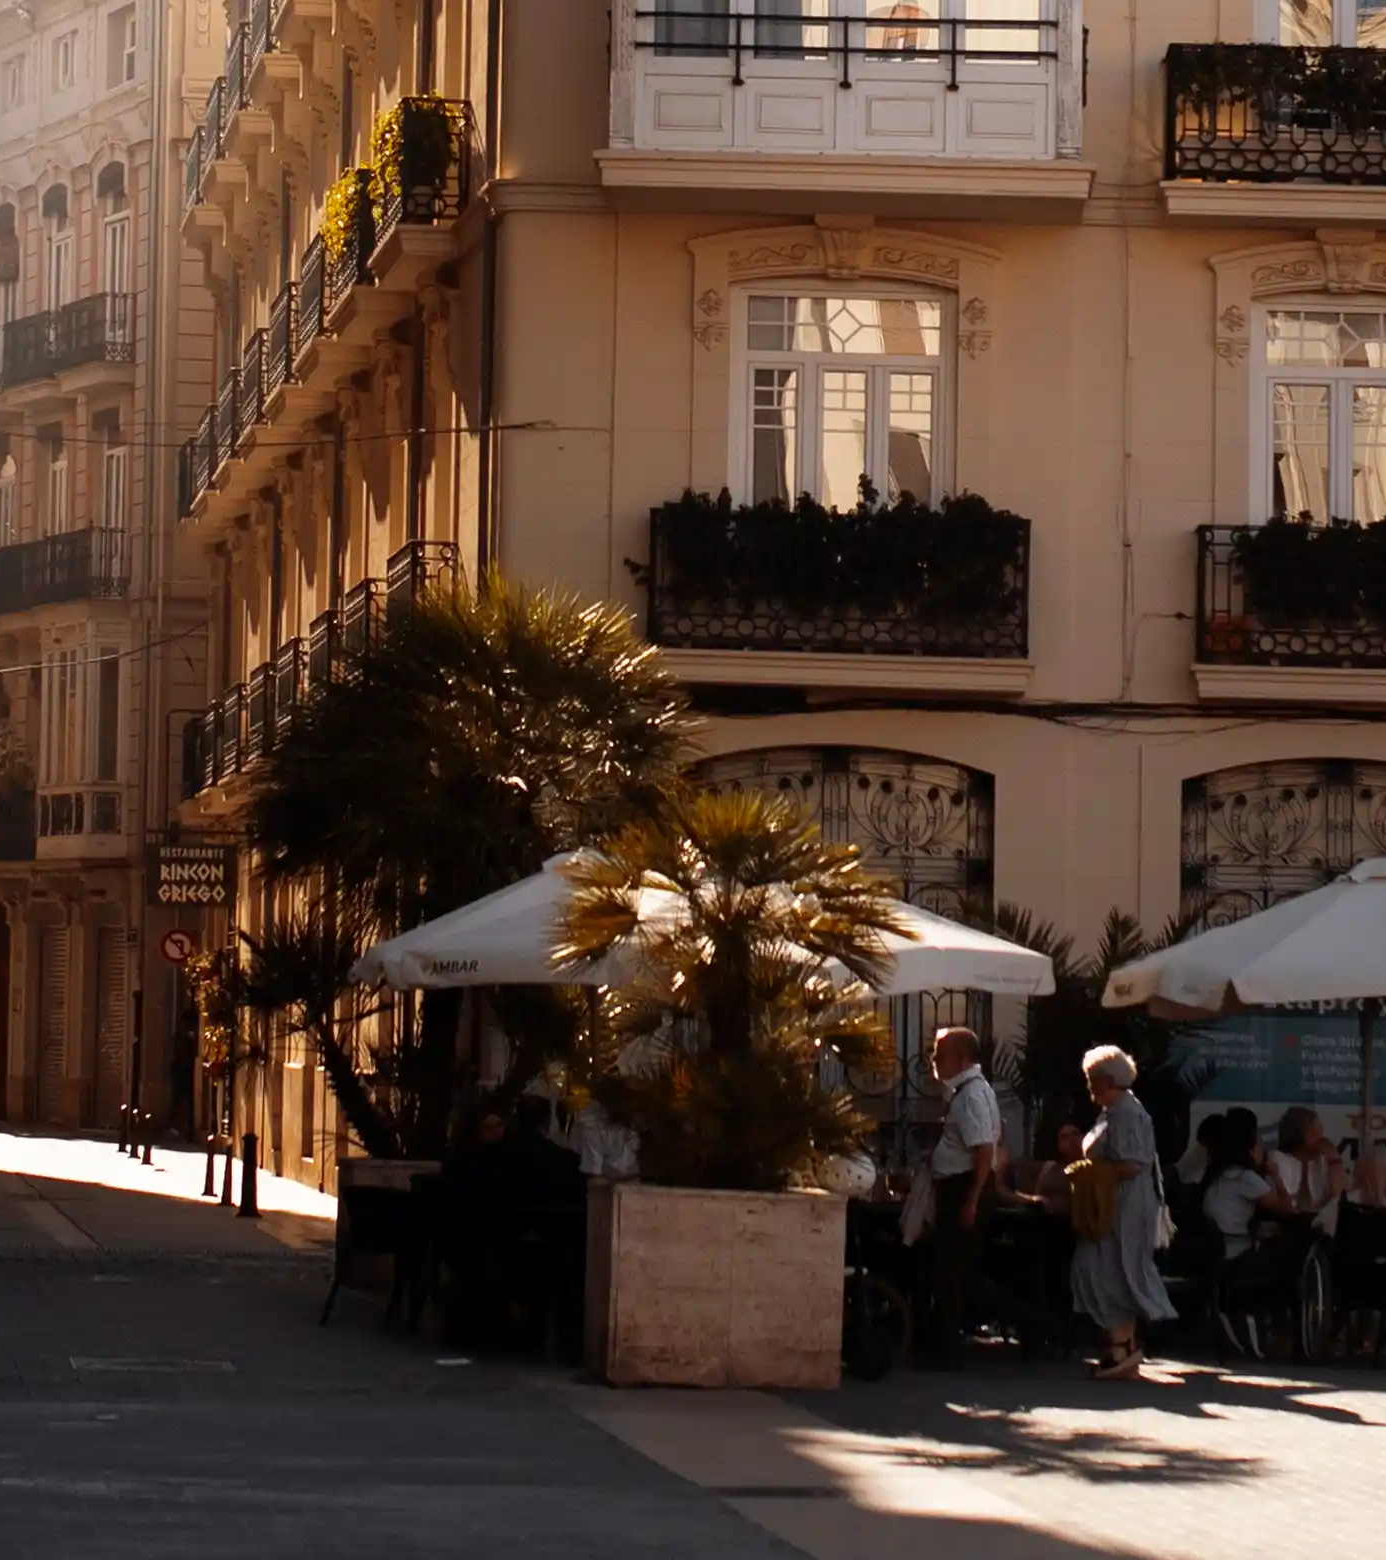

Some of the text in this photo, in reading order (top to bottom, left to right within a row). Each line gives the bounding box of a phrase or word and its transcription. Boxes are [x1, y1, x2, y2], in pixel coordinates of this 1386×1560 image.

[159, 847, 226, 860] RESTAURANTE
[157, 883, 226, 903] GRIEGO
[430, 959, 480, 975] AMBAR
